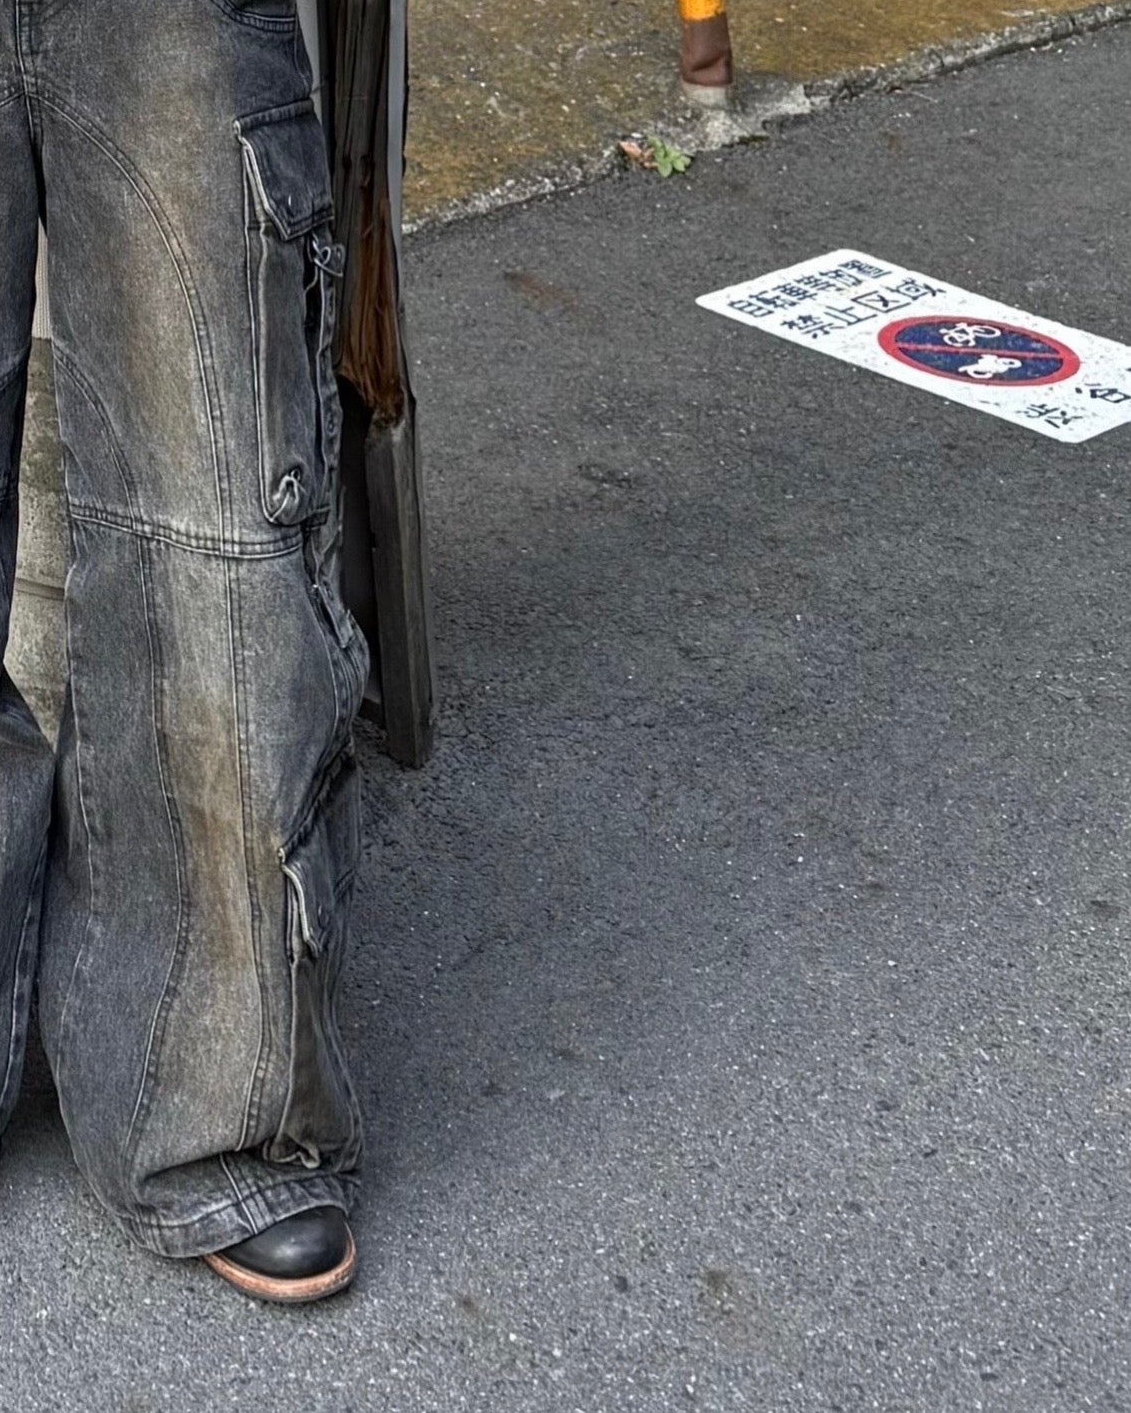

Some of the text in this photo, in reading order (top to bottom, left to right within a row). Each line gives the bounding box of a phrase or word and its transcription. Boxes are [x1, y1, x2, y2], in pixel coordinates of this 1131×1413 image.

[727, 259, 892, 318] 自転車等放置
[780, 277, 947, 339] 禁止区域
